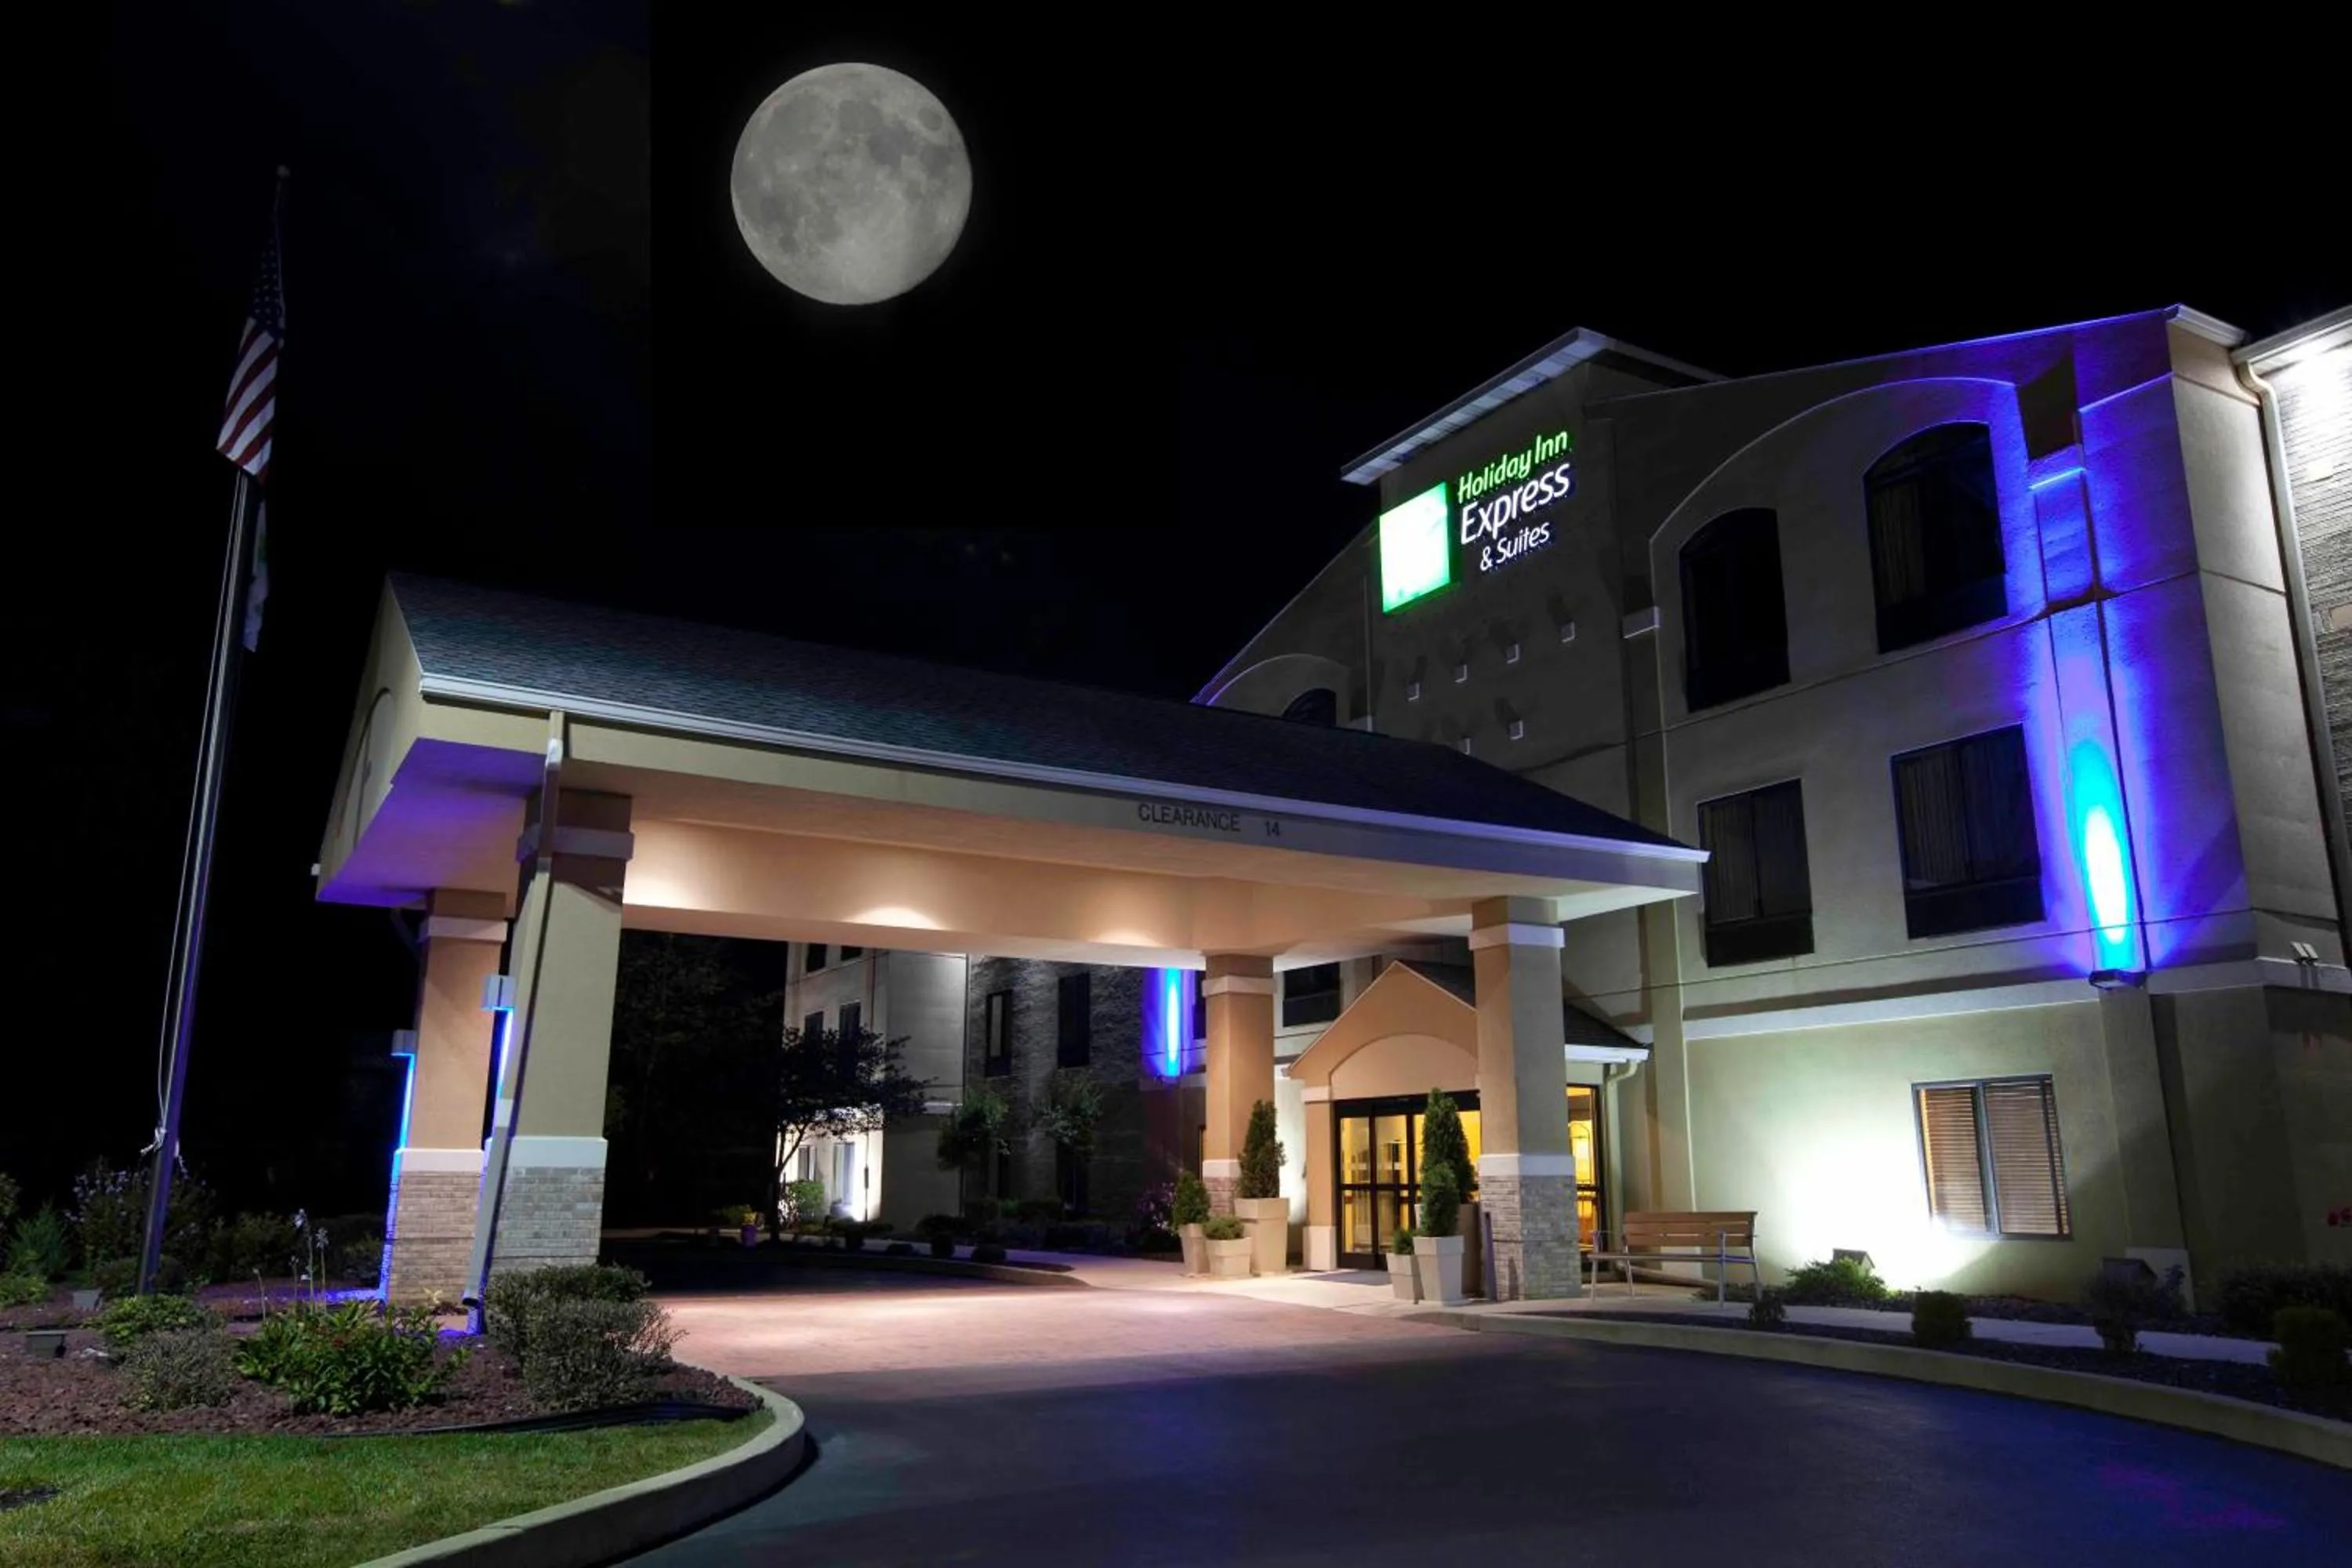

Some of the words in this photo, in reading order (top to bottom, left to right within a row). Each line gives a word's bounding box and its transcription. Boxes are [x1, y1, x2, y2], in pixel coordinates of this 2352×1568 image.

[1458, 450, 1532, 503] Holiday
[1534, 431, 1568, 464] Inn
[1461, 463, 1570, 545] Express
[1480, 546, 1494, 572] &
[1496, 522, 1550, 564] Suites
[1138, 804, 1241, 833] CLEARANCE
